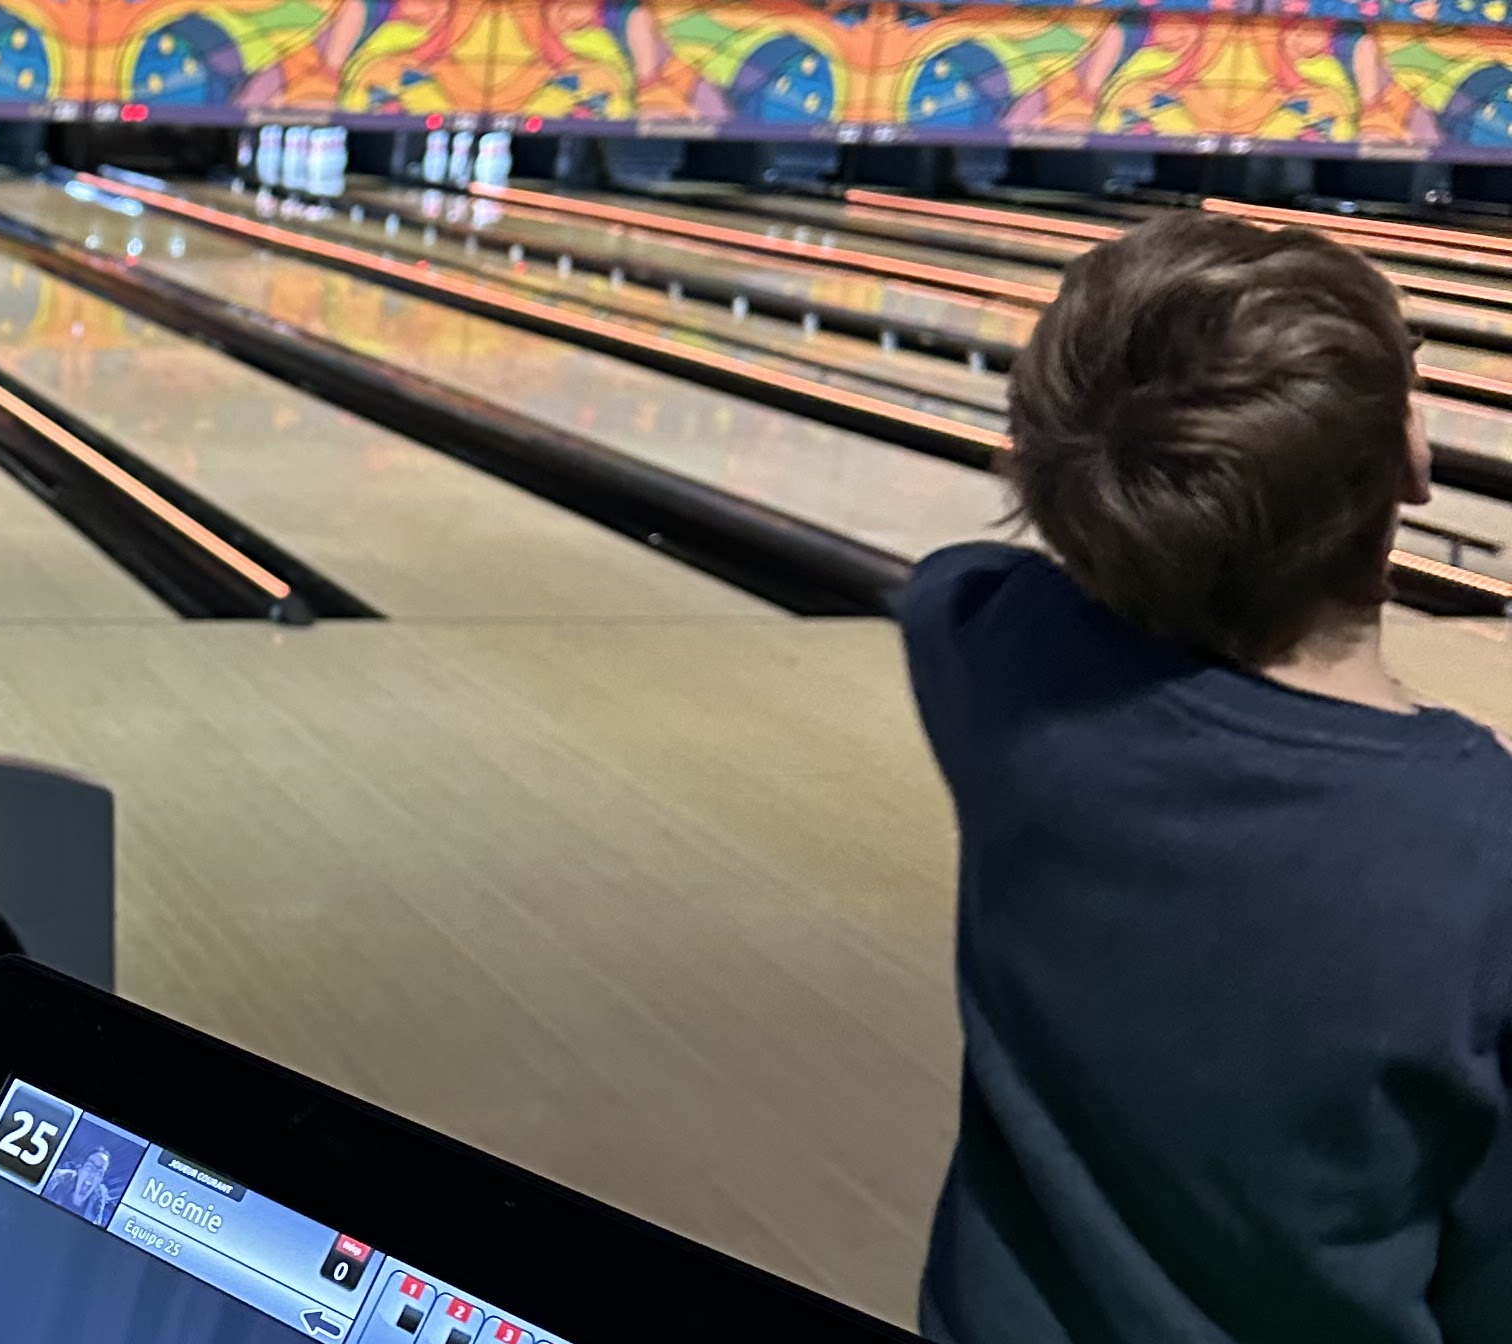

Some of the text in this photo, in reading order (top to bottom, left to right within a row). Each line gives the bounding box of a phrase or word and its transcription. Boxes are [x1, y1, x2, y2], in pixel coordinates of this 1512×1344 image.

[142, 1177, 223, 1233] Noémie
[164, 1239, 182, 1257] 25
[333, 1261, 349, 1281] 0
[408, 1283, 418, 1295] 1
[453, 1304, 465, 1318] 2
[502, 1327, 515, 1342] 3
